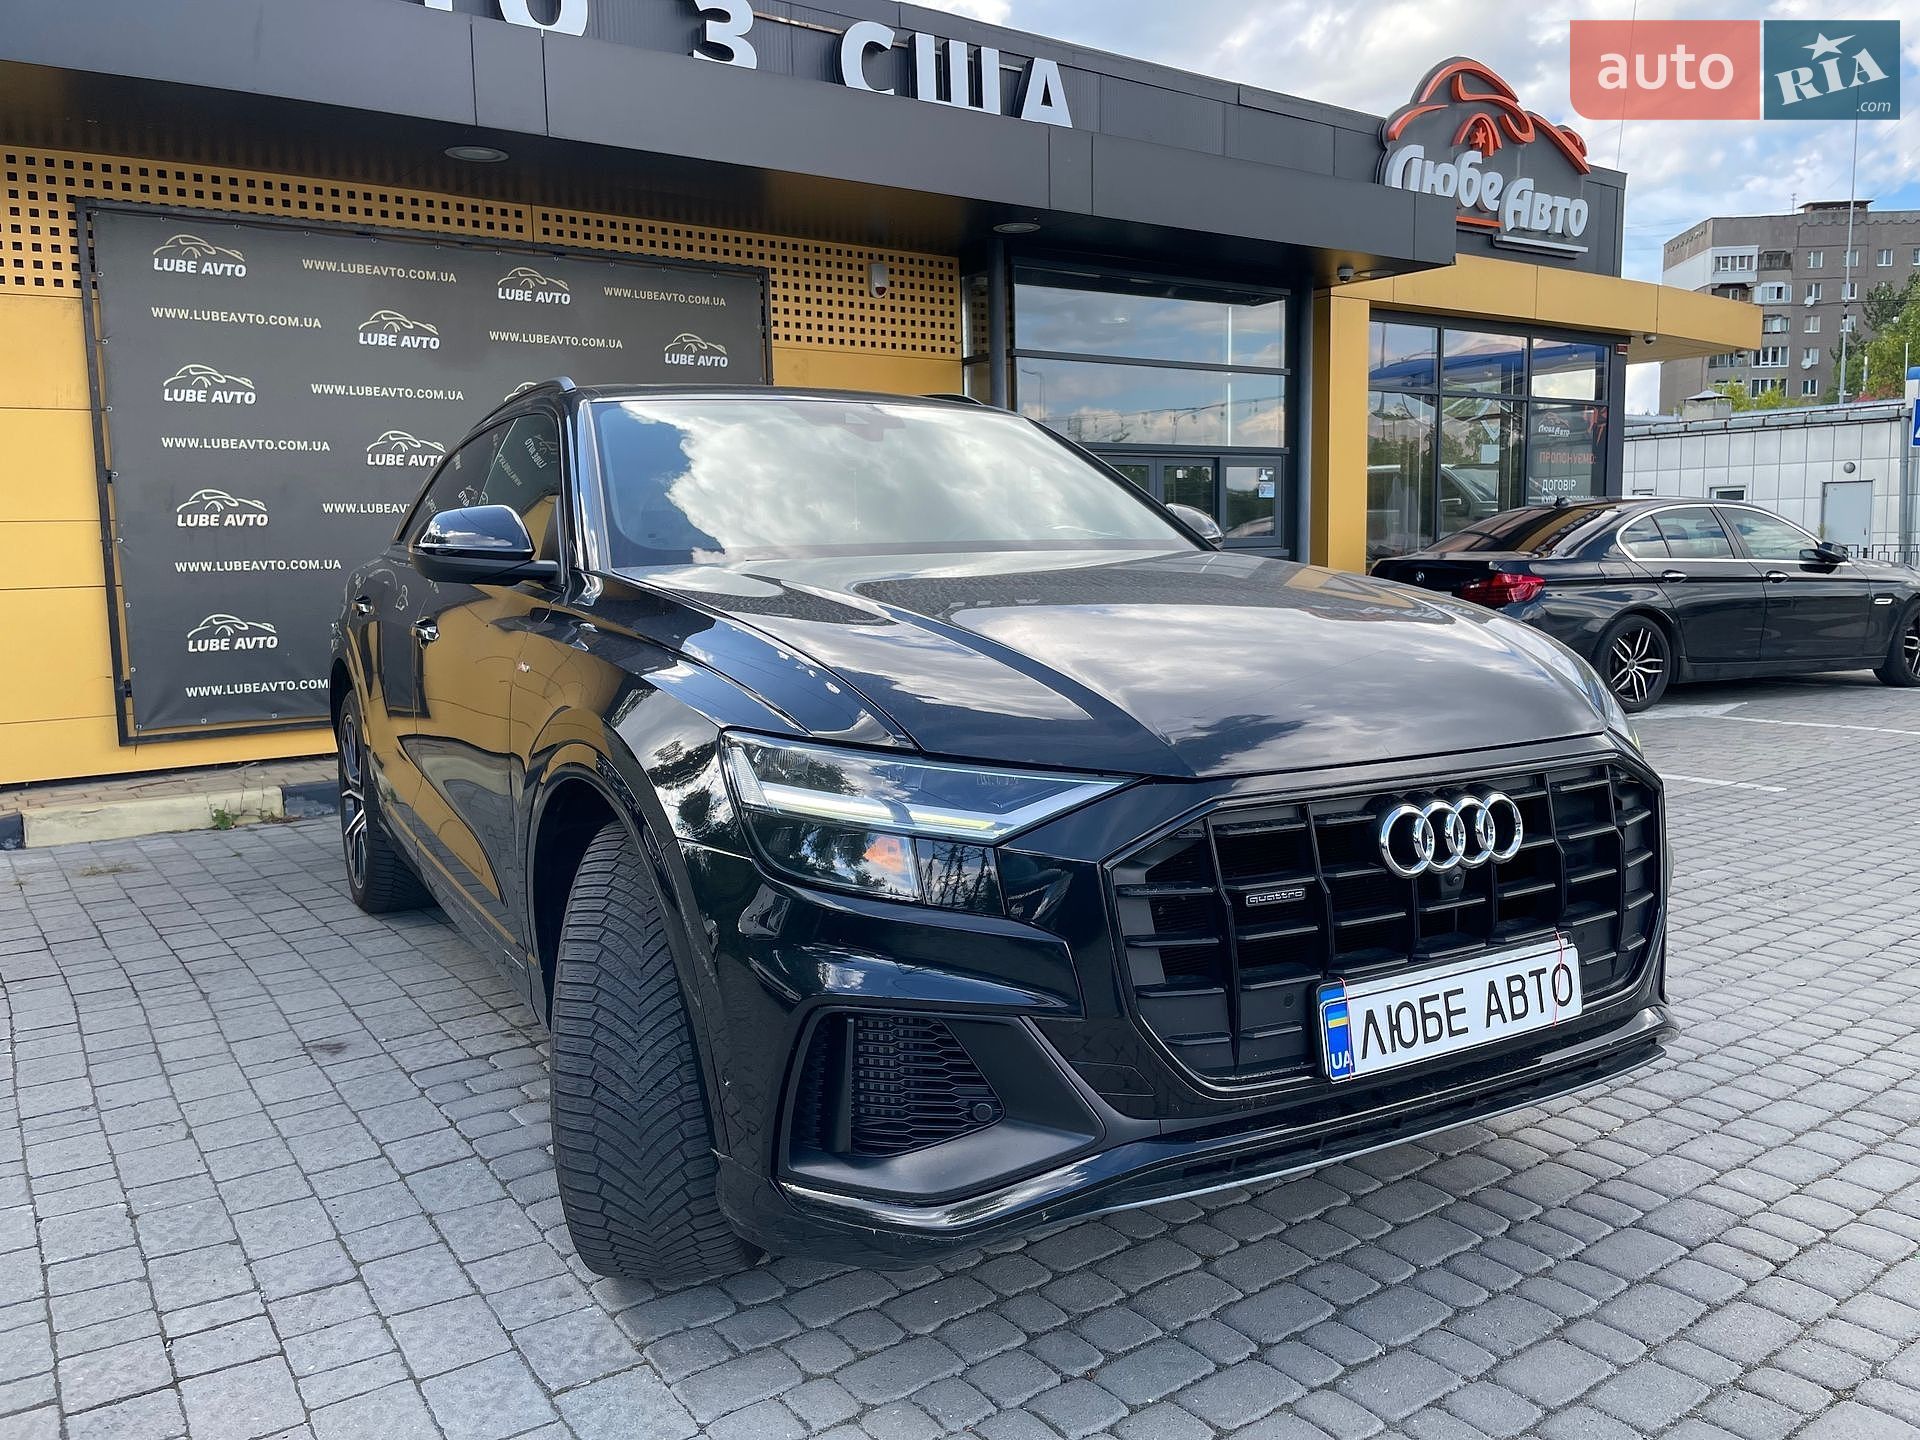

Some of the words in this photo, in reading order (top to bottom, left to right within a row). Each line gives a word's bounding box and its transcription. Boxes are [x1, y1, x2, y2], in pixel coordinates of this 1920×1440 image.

[840, 21, 1073, 129] США
[1385, 144, 1504, 212] Любе
[1503, 178, 1589, 238] Авто
[153, 258, 197, 274] LUBE
[201, 261, 247, 278] AVTO
[302, 258, 457, 283] WWW.LUBEAVTO.COM.UA
[497, 287, 532, 302] LUBE
[535, 290, 571, 305] AVTO
[603, 286, 726, 307] WWW.LUBEAVTO.COM.UA
[151, 306, 322, 329] WWW.LUBEAVTO.COM.UA
[358, 332, 397, 347] LUBE
[401, 335, 440, 350] AVTO
[489, 330, 623, 349] WWW.LUBEAVTO.COM.UA
[664, 352, 695, 366] LUBE
[698, 355, 728, 368] AVTO
[163, 388, 207, 403] LUBE
[211, 390, 256, 405] AVTO
[310, 383, 464, 401] WWW.LUBEAVTO.COM.UA
[161, 437, 331, 452] WWW.LUBEAVTO.COM.UA
[366, 453, 405, 466] LUBE
[1542, 479, 1577, 493] ДОГОВІР
[322, 503, 410, 514] WWW.LUBEAV
[176, 513, 220, 527] LUBE
[224, 513, 269, 527] AVTO
[174, 559, 342, 573] WWW.LUBEAVTO.COM.UA
[187, 638, 230, 653] LUBE
[234, 636, 278, 651] AVTO
[185, 678, 329, 698] WWW.LUBEAVTO.COM
[1249, 890, 1303, 904] quattro
[1361, 987, 1469, 1060] ЛЮБЕ
[1485, 963, 1574, 1029] АВТО
[1331, 1050, 1354, 1070] UA
